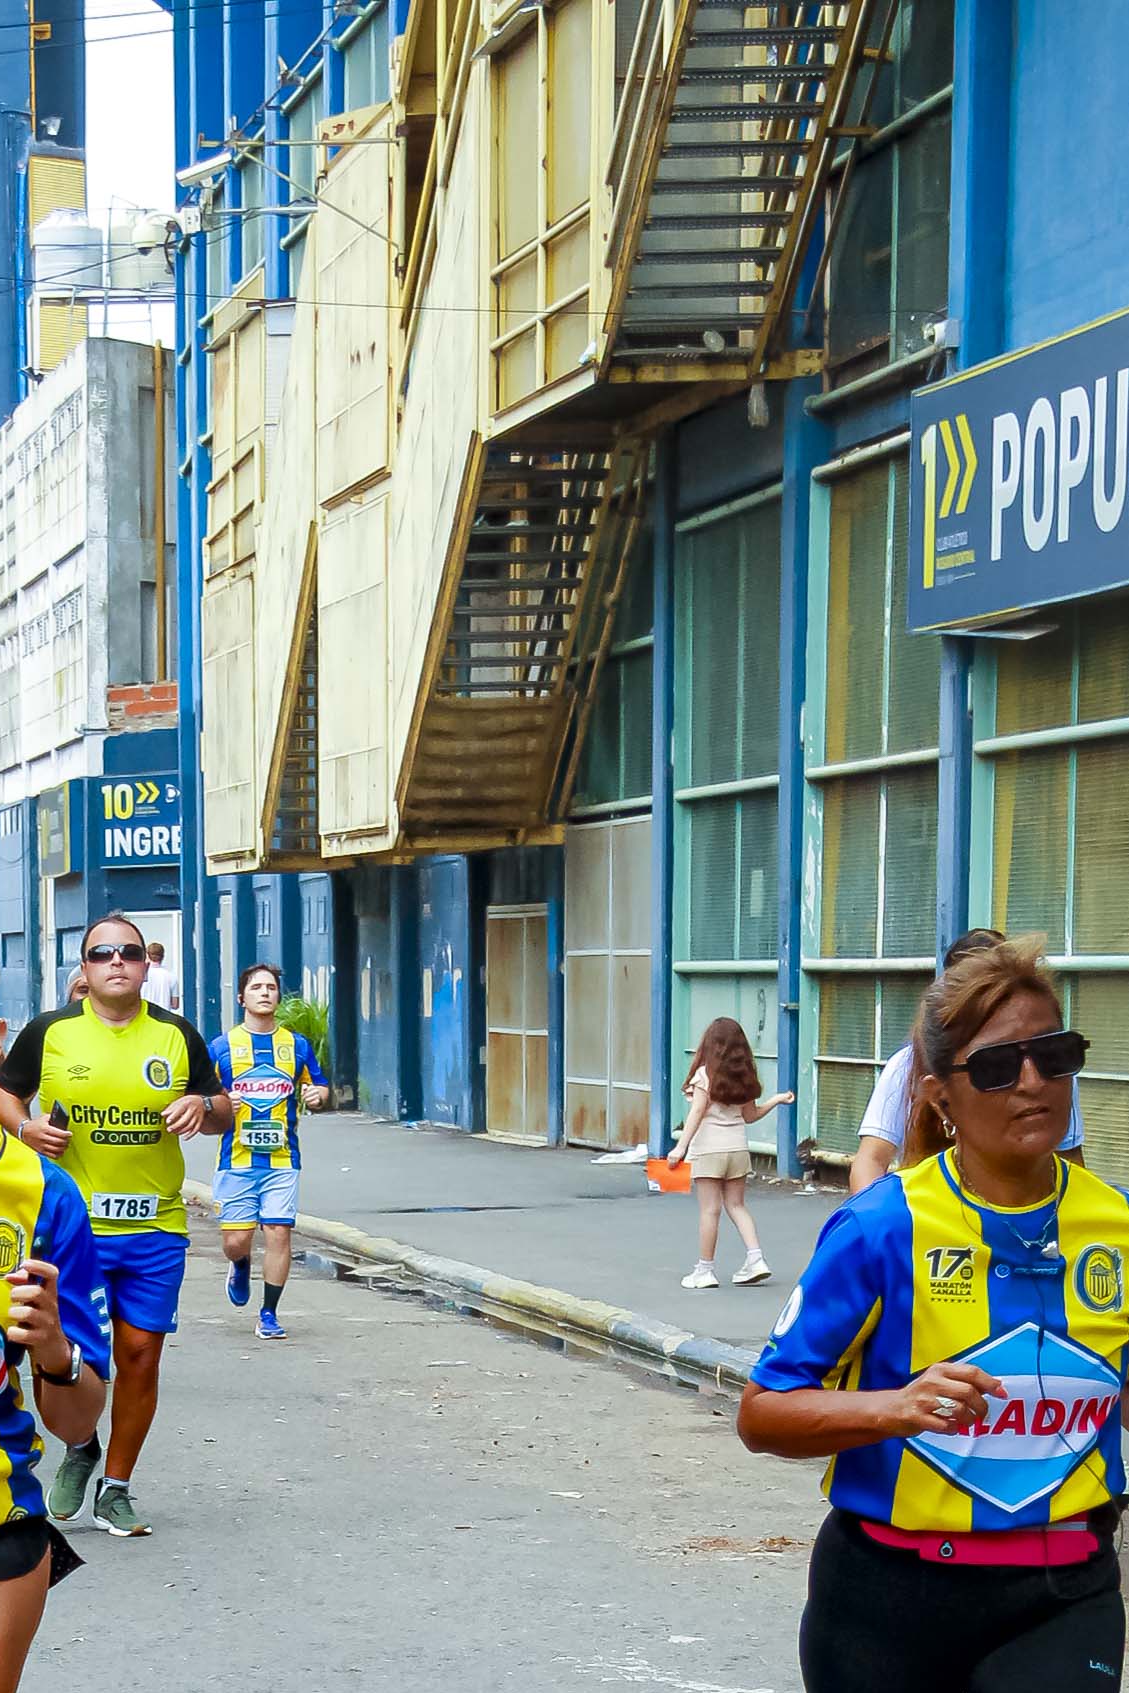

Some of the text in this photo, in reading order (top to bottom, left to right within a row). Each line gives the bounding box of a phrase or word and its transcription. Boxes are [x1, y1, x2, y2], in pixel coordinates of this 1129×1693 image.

[991, 368, 1129, 562] POPU
[101, 783, 134, 820] 10
[246, 1132, 280, 1145] 1553
[101, 1198, 151, 1218] 1785
[926, 1248, 976, 1279] 17
[930, 1288, 972, 1296] CANALLA
